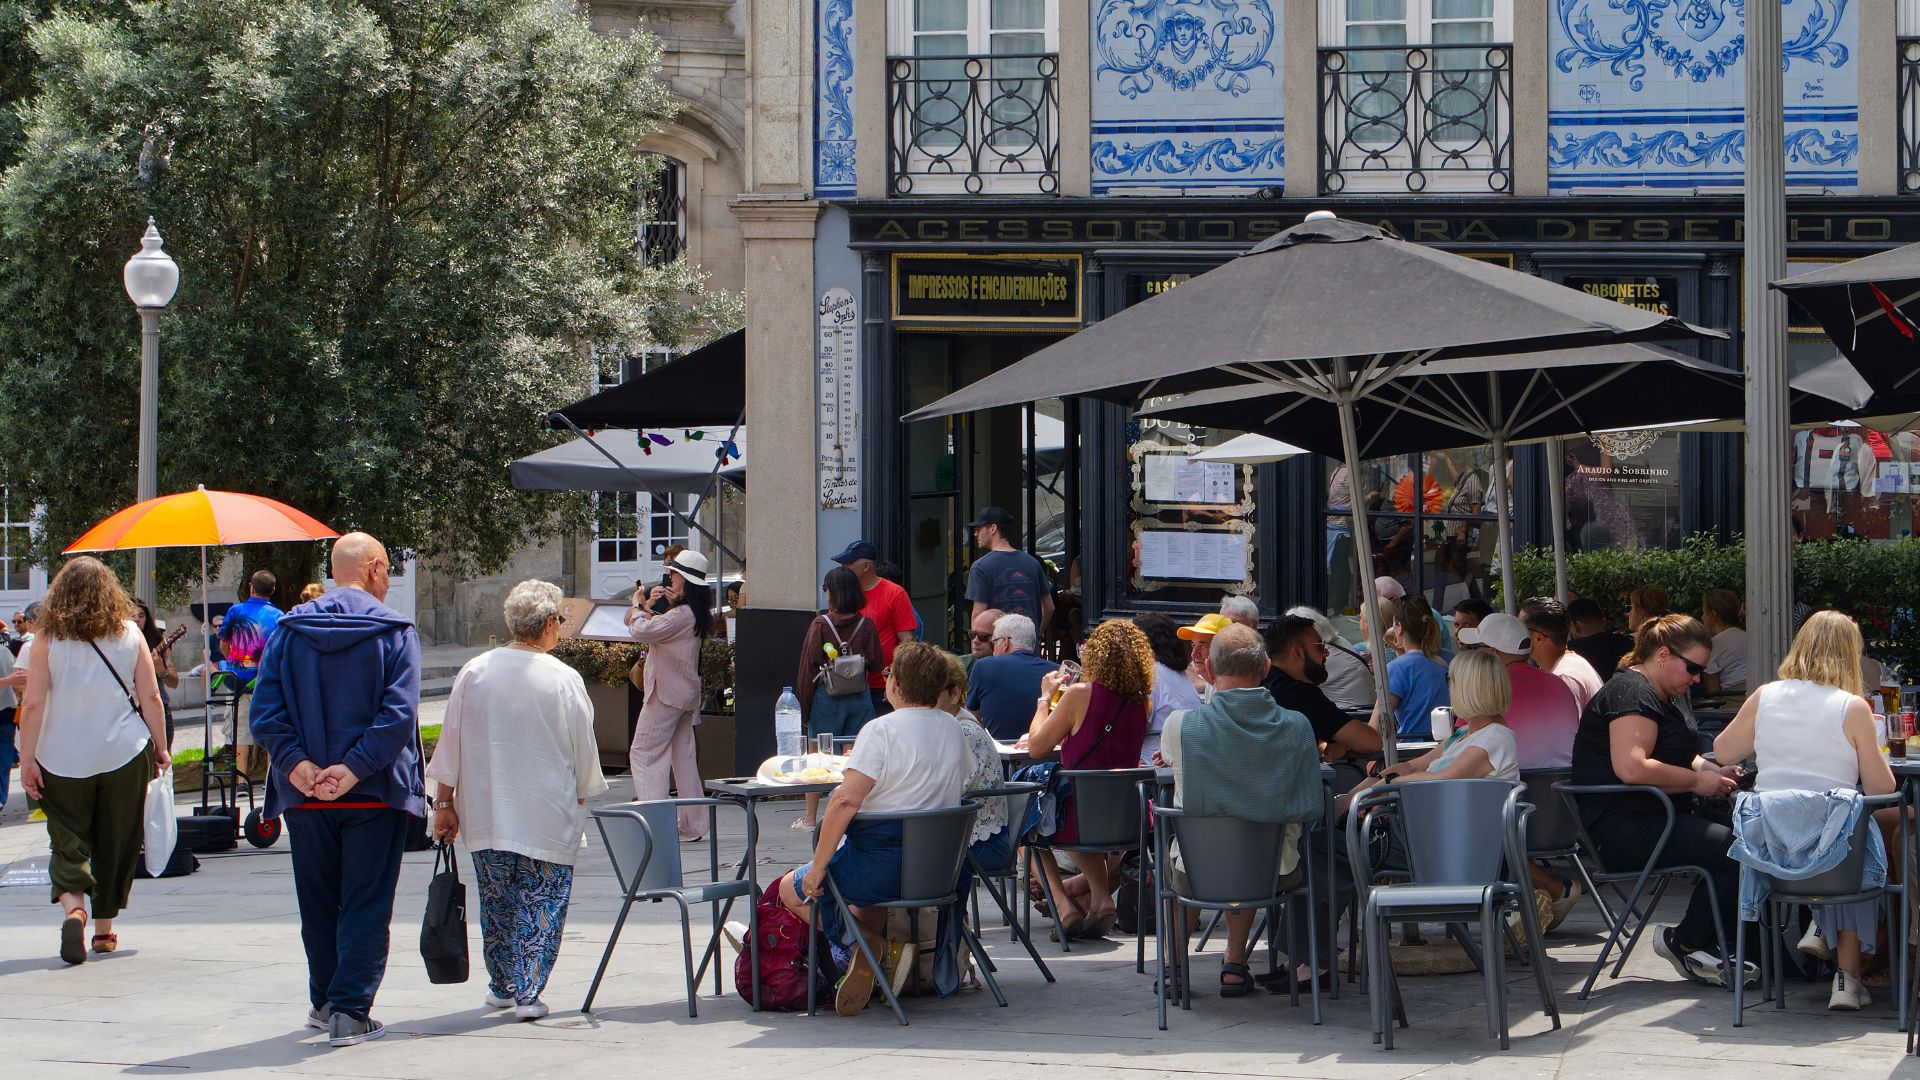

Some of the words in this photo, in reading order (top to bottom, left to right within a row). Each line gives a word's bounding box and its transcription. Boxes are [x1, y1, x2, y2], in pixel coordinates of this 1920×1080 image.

[873, 219, 1281, 241] ACESSORIOS
[1374, 219, 1499, 241] ARA
[1536, 219, 1891, 241] DESEHO
[908, 274, 970, 300] IMPRESSOS
[971, 275, 978, 300] E
[979, 271, 1068, 307] ENCADERNAÇÕES
[1582, 283, 1660, 298] SABONETES
[1577, 464, 1612, 475] ARAUJO
[1613, 467, 1621, 475] &
[1622, 465, 1669, 476] SOBRINHO
